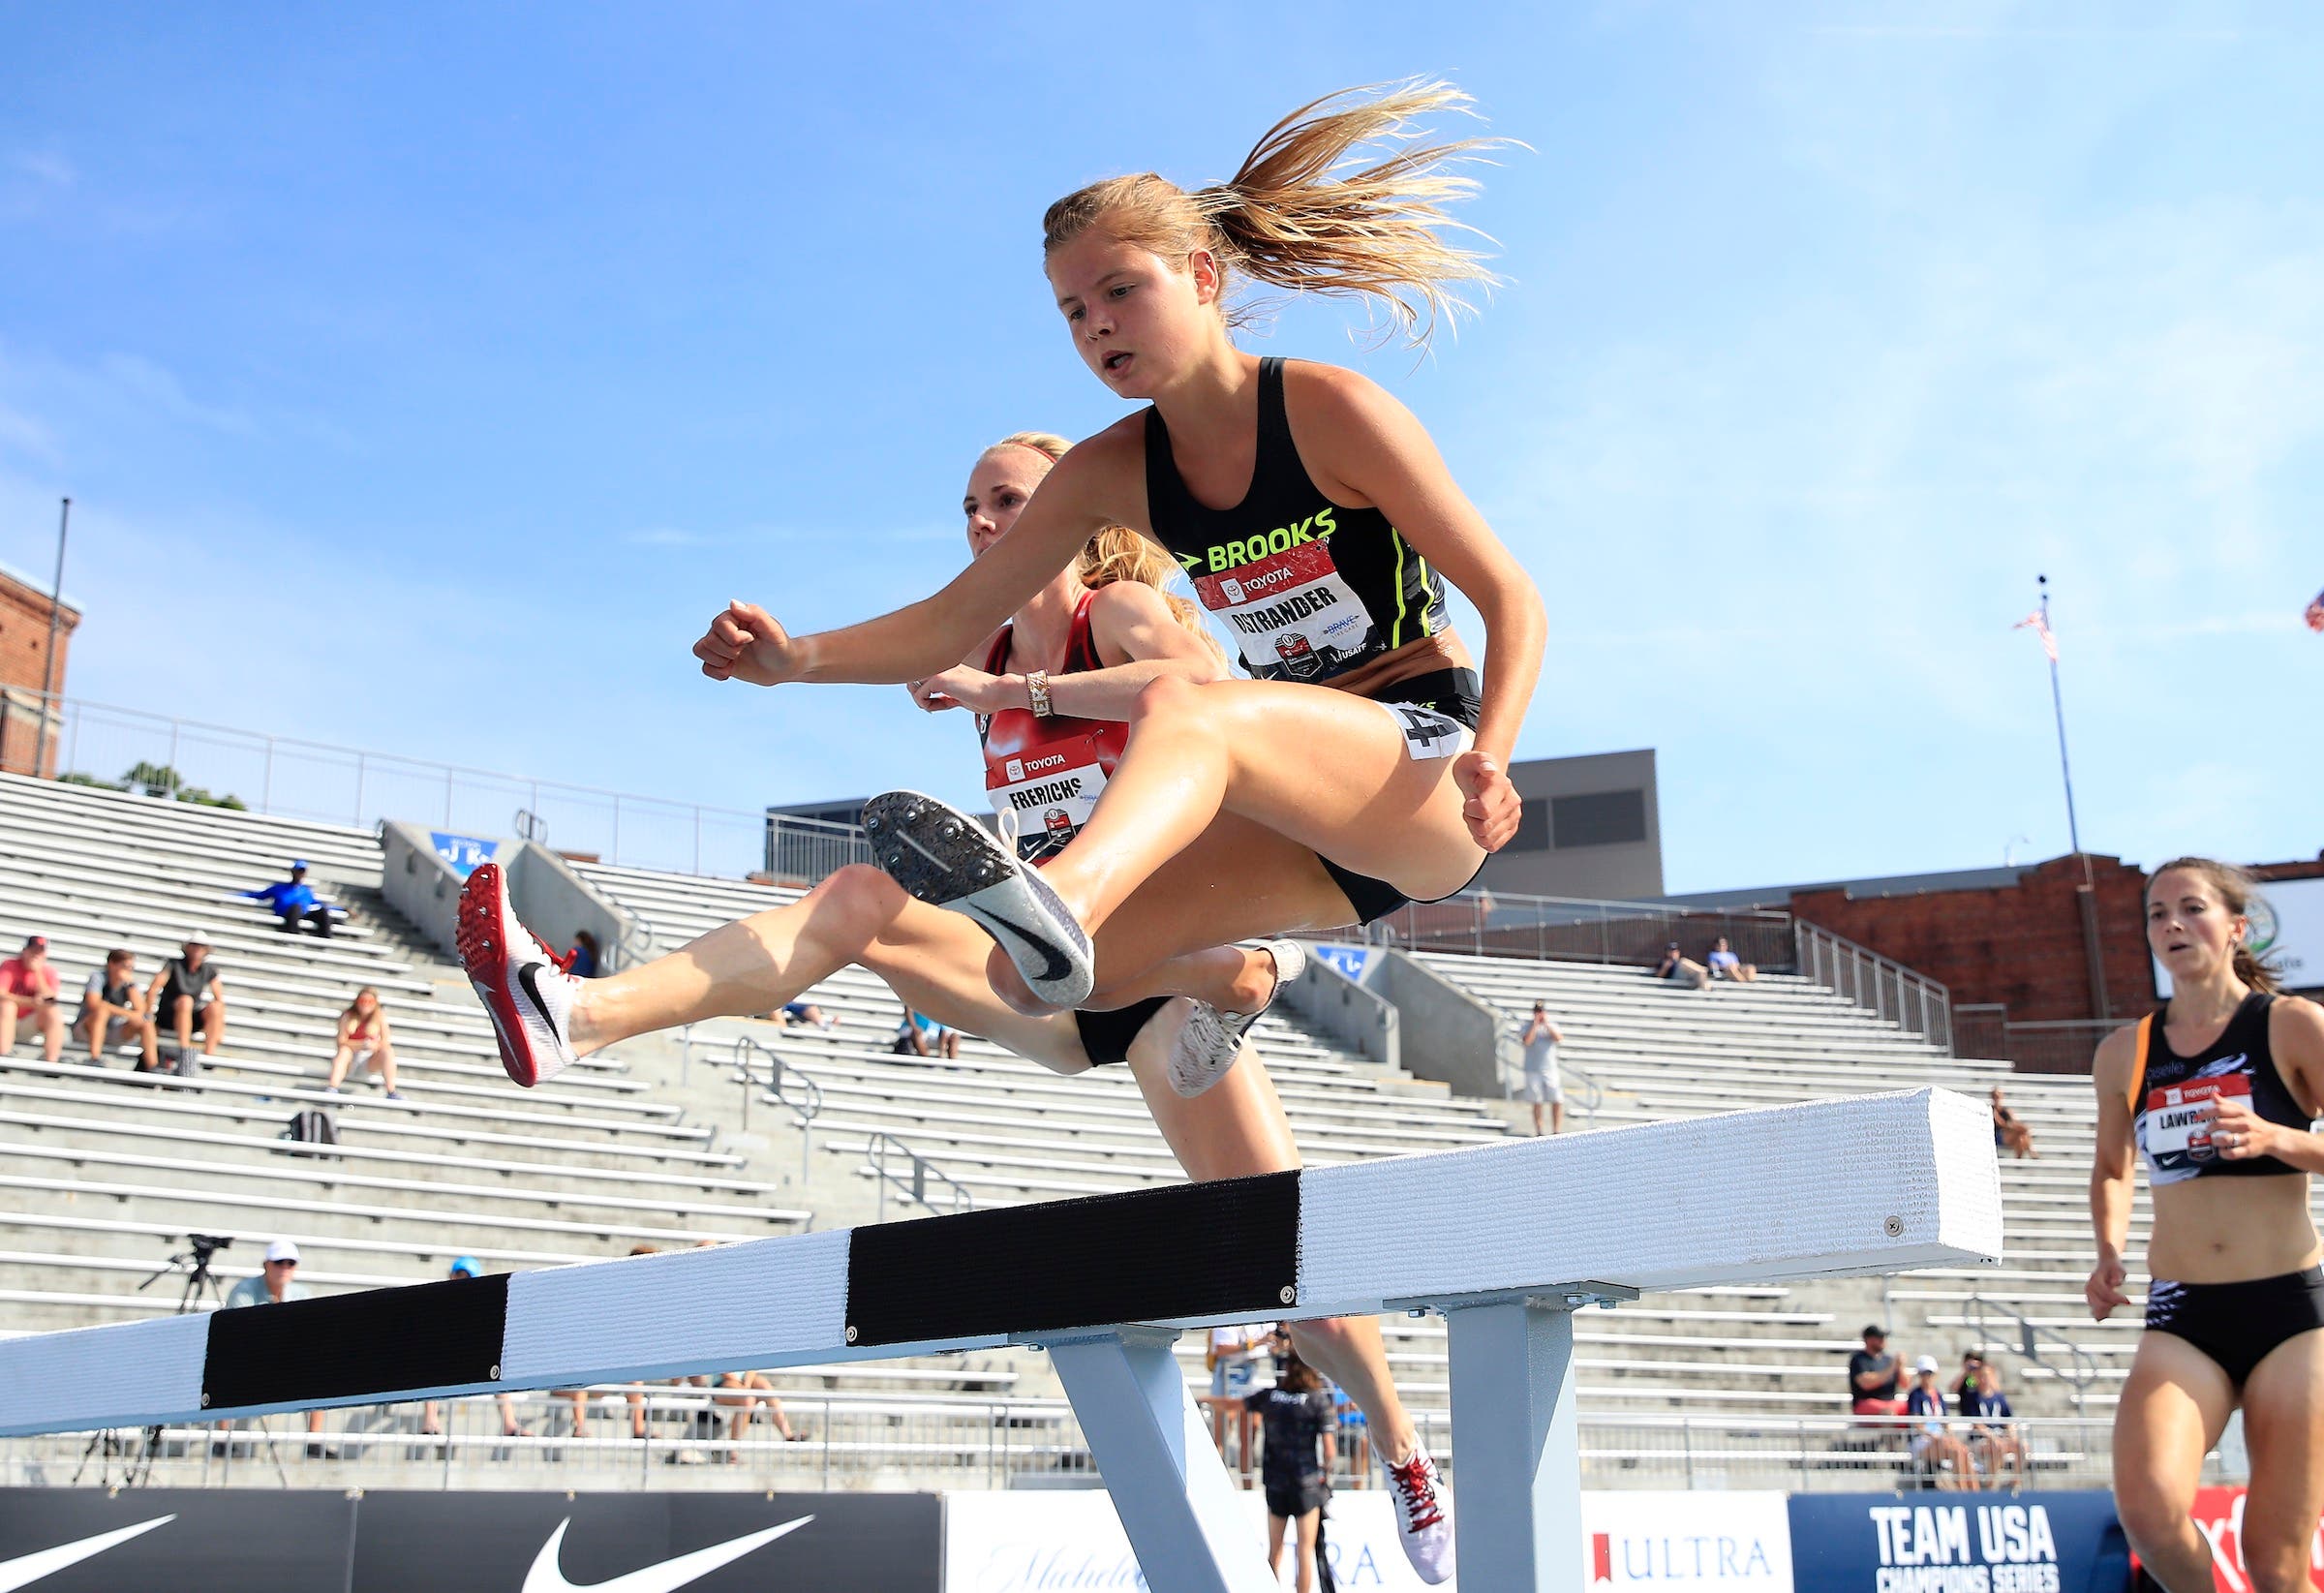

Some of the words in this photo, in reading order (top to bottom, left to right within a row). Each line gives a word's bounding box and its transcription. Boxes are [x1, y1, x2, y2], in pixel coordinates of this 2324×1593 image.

[1208, 506, 1336, 572] BROOKS
[1242, 567, 1294, 593] TOYOTA
[1231, 585, 1338, 635] OSTRANDER
[1327, 614, 1357, 634] BRAVE
[1342, 642, 1367, 659] USATF
[1024, 754, 1066, 772] TOYOTA
[1009, 777, 1083, 811] FRERICHS
[2184, 1085, 2221, 1099] TOYOTA
[1869, 1506, 1972, 1566] TEAM
[1976, 1505, 2058, 1564] USA
[1623, 1535, 1773, 1580] ULTRA
[1876, 1565, 1991, 1593] CHAMPIONS
[1991, 1562, 2062, 1593] SERIES
